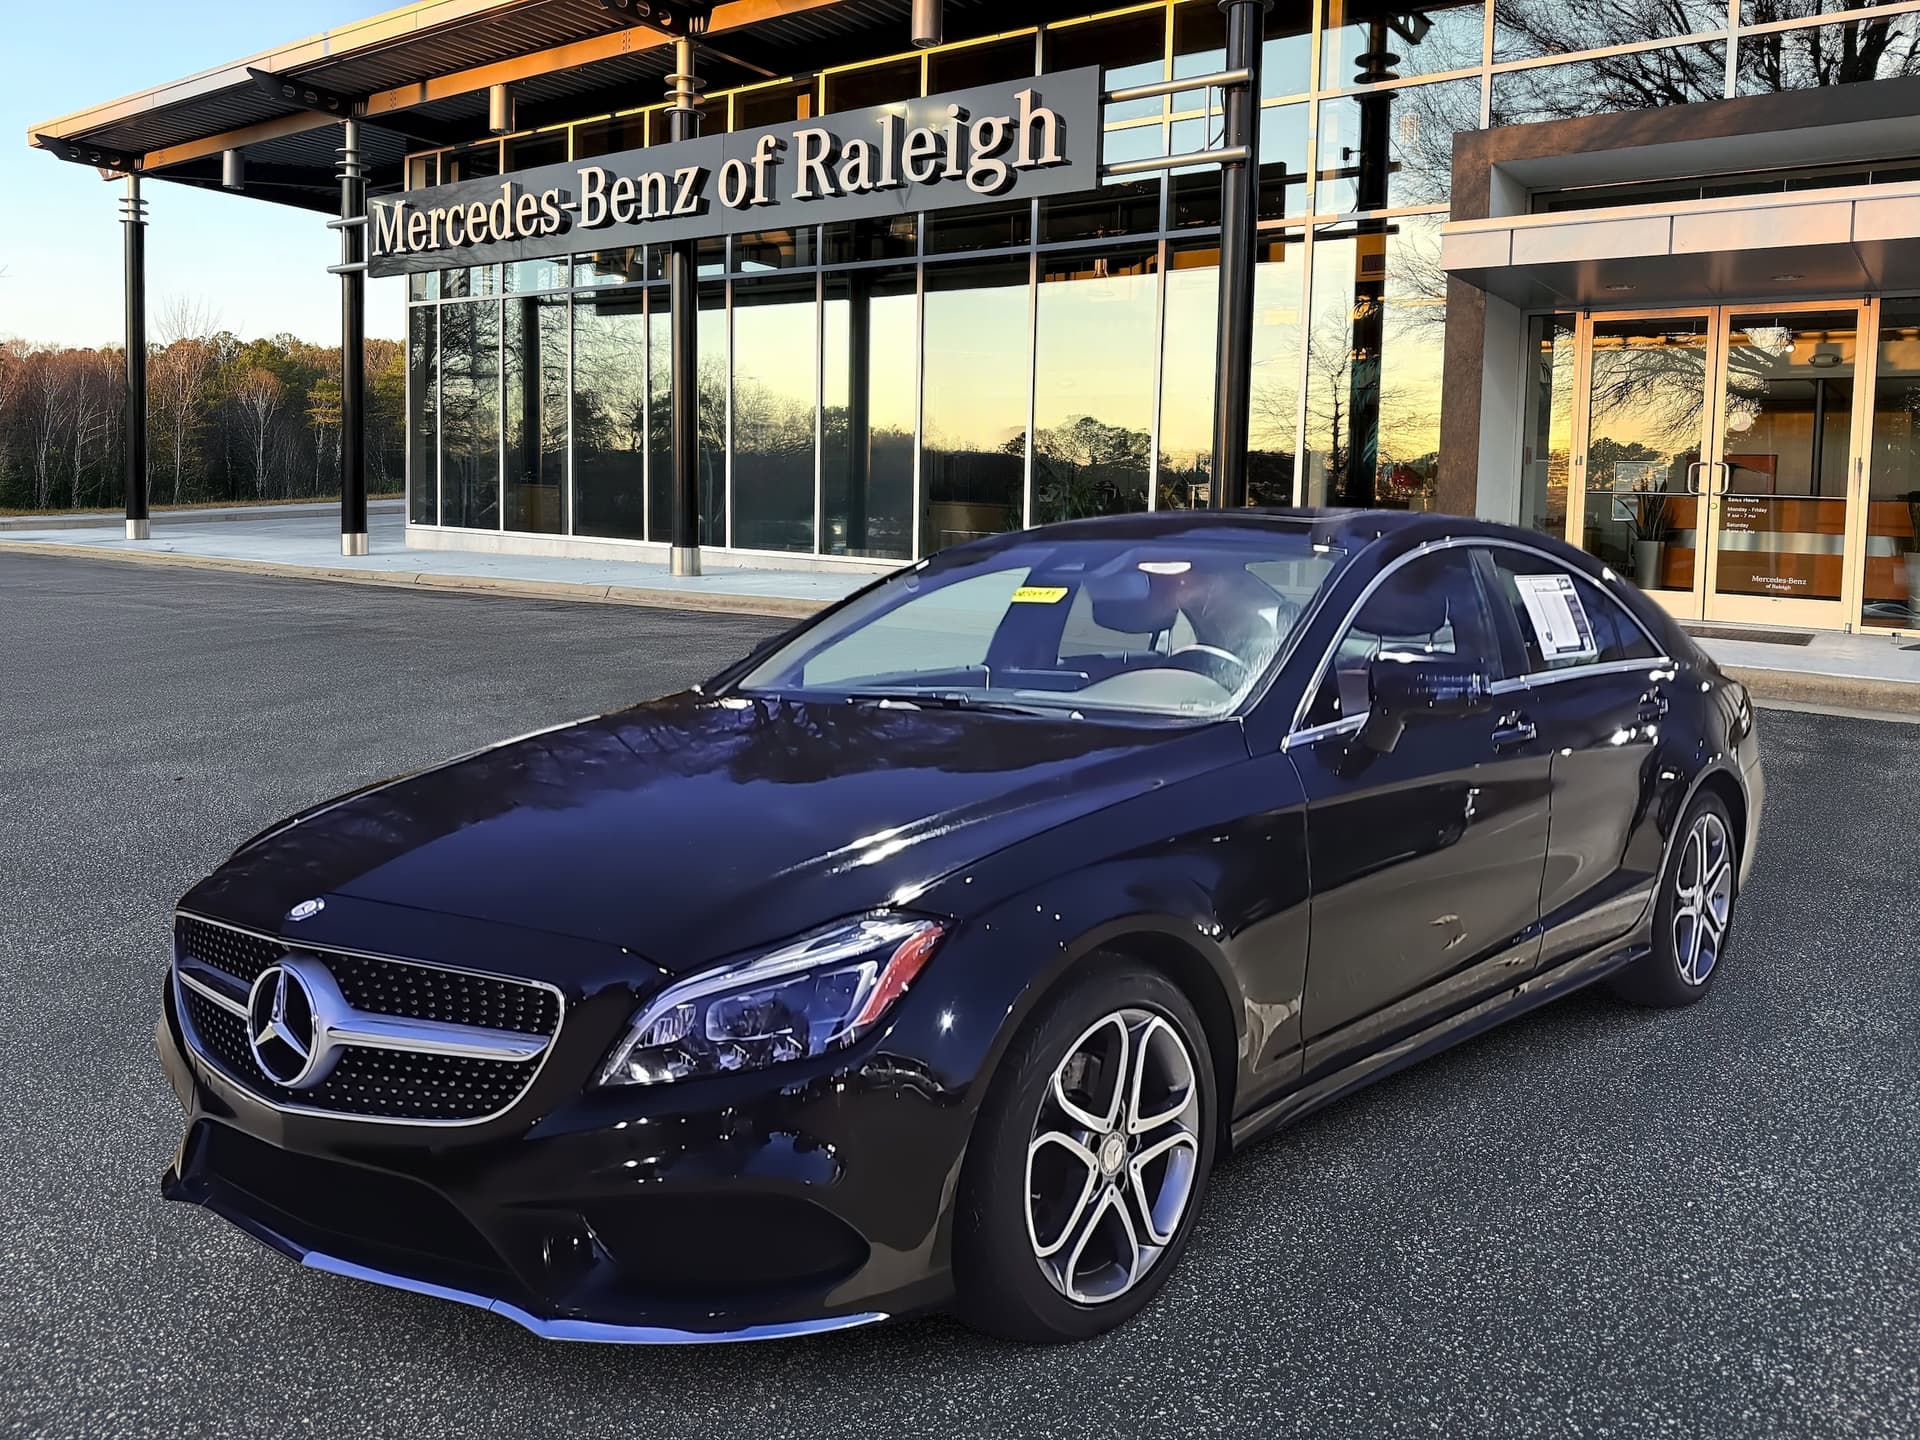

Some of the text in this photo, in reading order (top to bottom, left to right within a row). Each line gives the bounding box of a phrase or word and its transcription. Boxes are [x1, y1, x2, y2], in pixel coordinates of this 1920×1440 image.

[371, 87, 1067, 257] Mercedes-Benz of Raleigh
[1751, 506, 1768, 514] Friday
[1751, 575, 1807, 585] Mercedes-Benz
